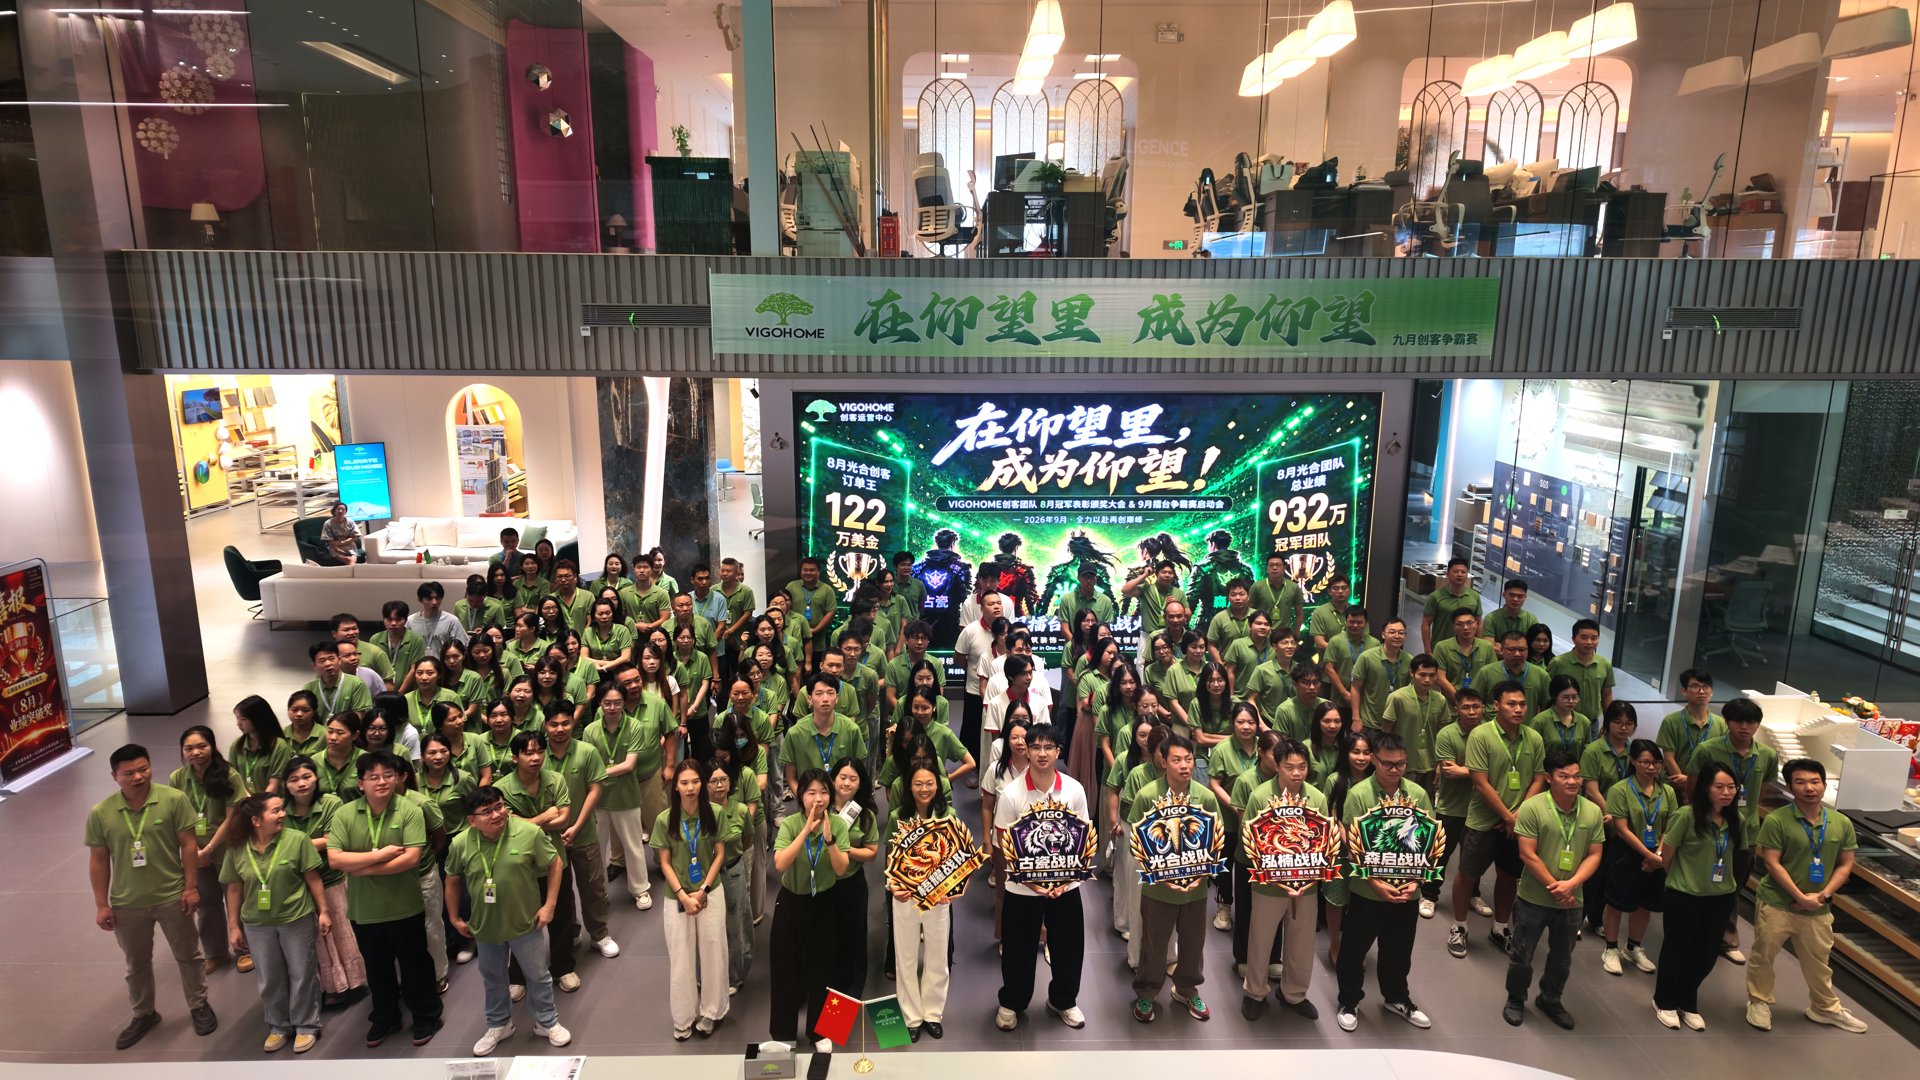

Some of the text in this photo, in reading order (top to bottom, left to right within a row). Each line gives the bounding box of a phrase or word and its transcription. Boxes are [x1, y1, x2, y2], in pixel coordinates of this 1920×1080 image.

[853, 288, 1377, 346] 在仰望里 成为仰望
[745, 326, 825, 339] VIGOHOME
[1392, 333, 1479, 347] 九月创客争霸赛
[839, 403, 895, 413] VIGOHOME
[840, 413, 893, 422] 创客运营中心
[826, 457, 891, 480] 8月光合创客
[1276, 457, 1345, 480] 8月光合团队
[842, 474, 877, 491] 订单王
[1290, 474, 1327, 491] 总业绩
[825, 491, 887, 533] 122
[948, 500, 1038, 509] VIGOHOME创客团队
[1128, 500, 1136, 509] &
[1138, 499, 1225, 509] 9月擂台争霸赛启动会
[835, 531, 880, 550] 万美金
[1274, 532, 1332, 552] 冠军团队
[20, 694, 36, 713] 8月
[1035, 810, 1064, 820] VIGO
[1159, 806, 1188, 817] VIGO
[1274, 807, 1304, 816] VIGO
[1384, 807, 1413, 816] VIGO
[900, 827, 925, 849] VIGO
[1018, 854, 1084, 870] 古瓷战队
[1149, 848, 1215, 869] 光合战队
[1261, 852, 1329, 868] 泓楠战队
[1363, 851, 1431, 867] 森启战队
